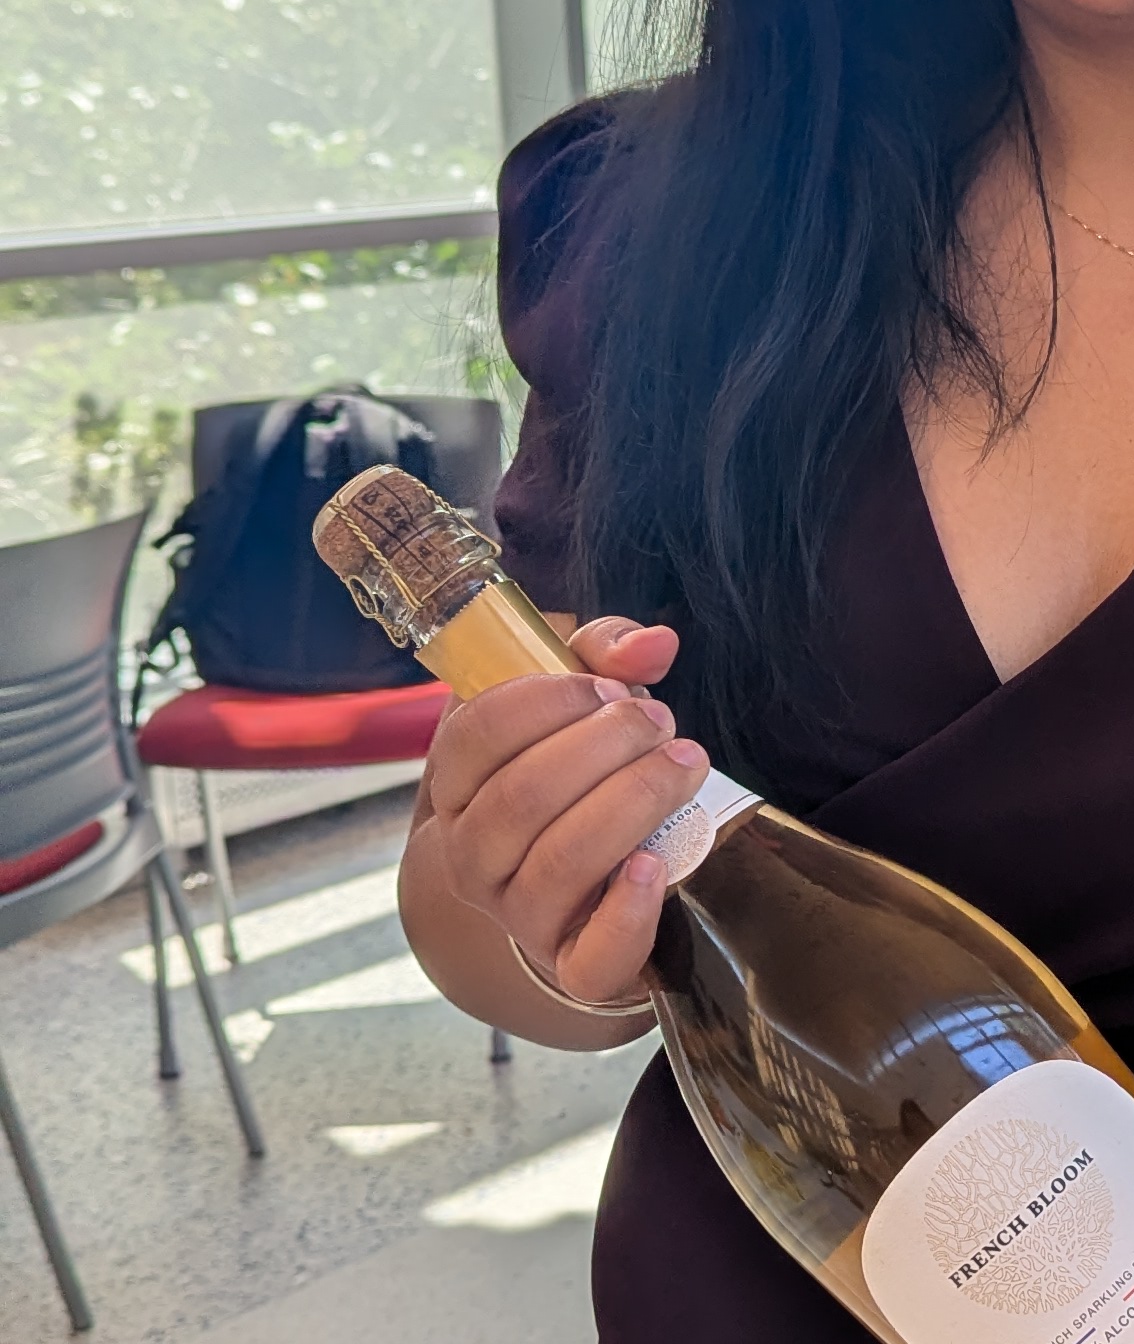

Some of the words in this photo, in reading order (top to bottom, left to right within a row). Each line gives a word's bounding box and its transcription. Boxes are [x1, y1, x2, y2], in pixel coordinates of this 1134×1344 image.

[664, 802, 702, 831] BLOOM
[947, 1214, 1029, 1289] FRENCH
[1026, 1148, 1094, 1218] BLOOM
[1072, 1269, 1133, 1330] SPARKLING
